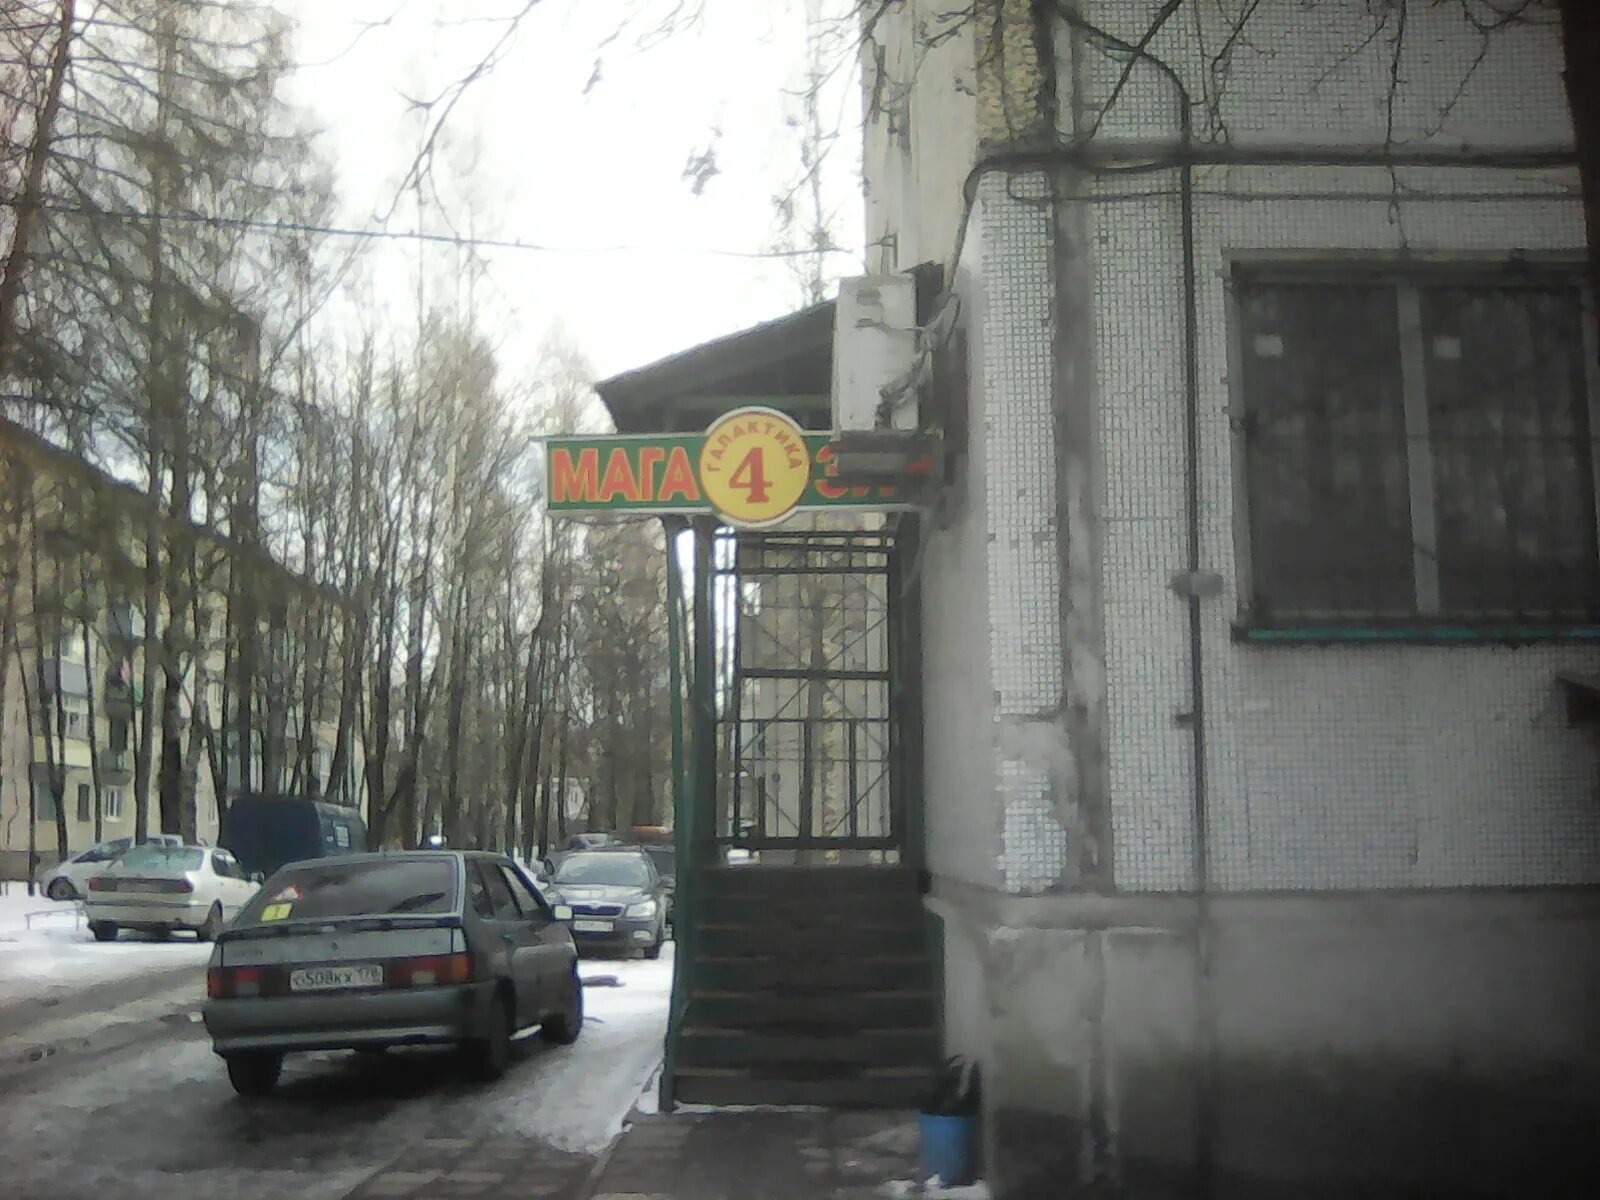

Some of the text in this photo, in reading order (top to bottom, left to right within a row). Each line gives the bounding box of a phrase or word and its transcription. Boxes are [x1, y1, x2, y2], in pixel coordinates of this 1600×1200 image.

[550, 446, 700, 502] МАГА
[707, 421, 802, 472] ГАЛАКТИКА
[728, 447, 773, 504] 4
